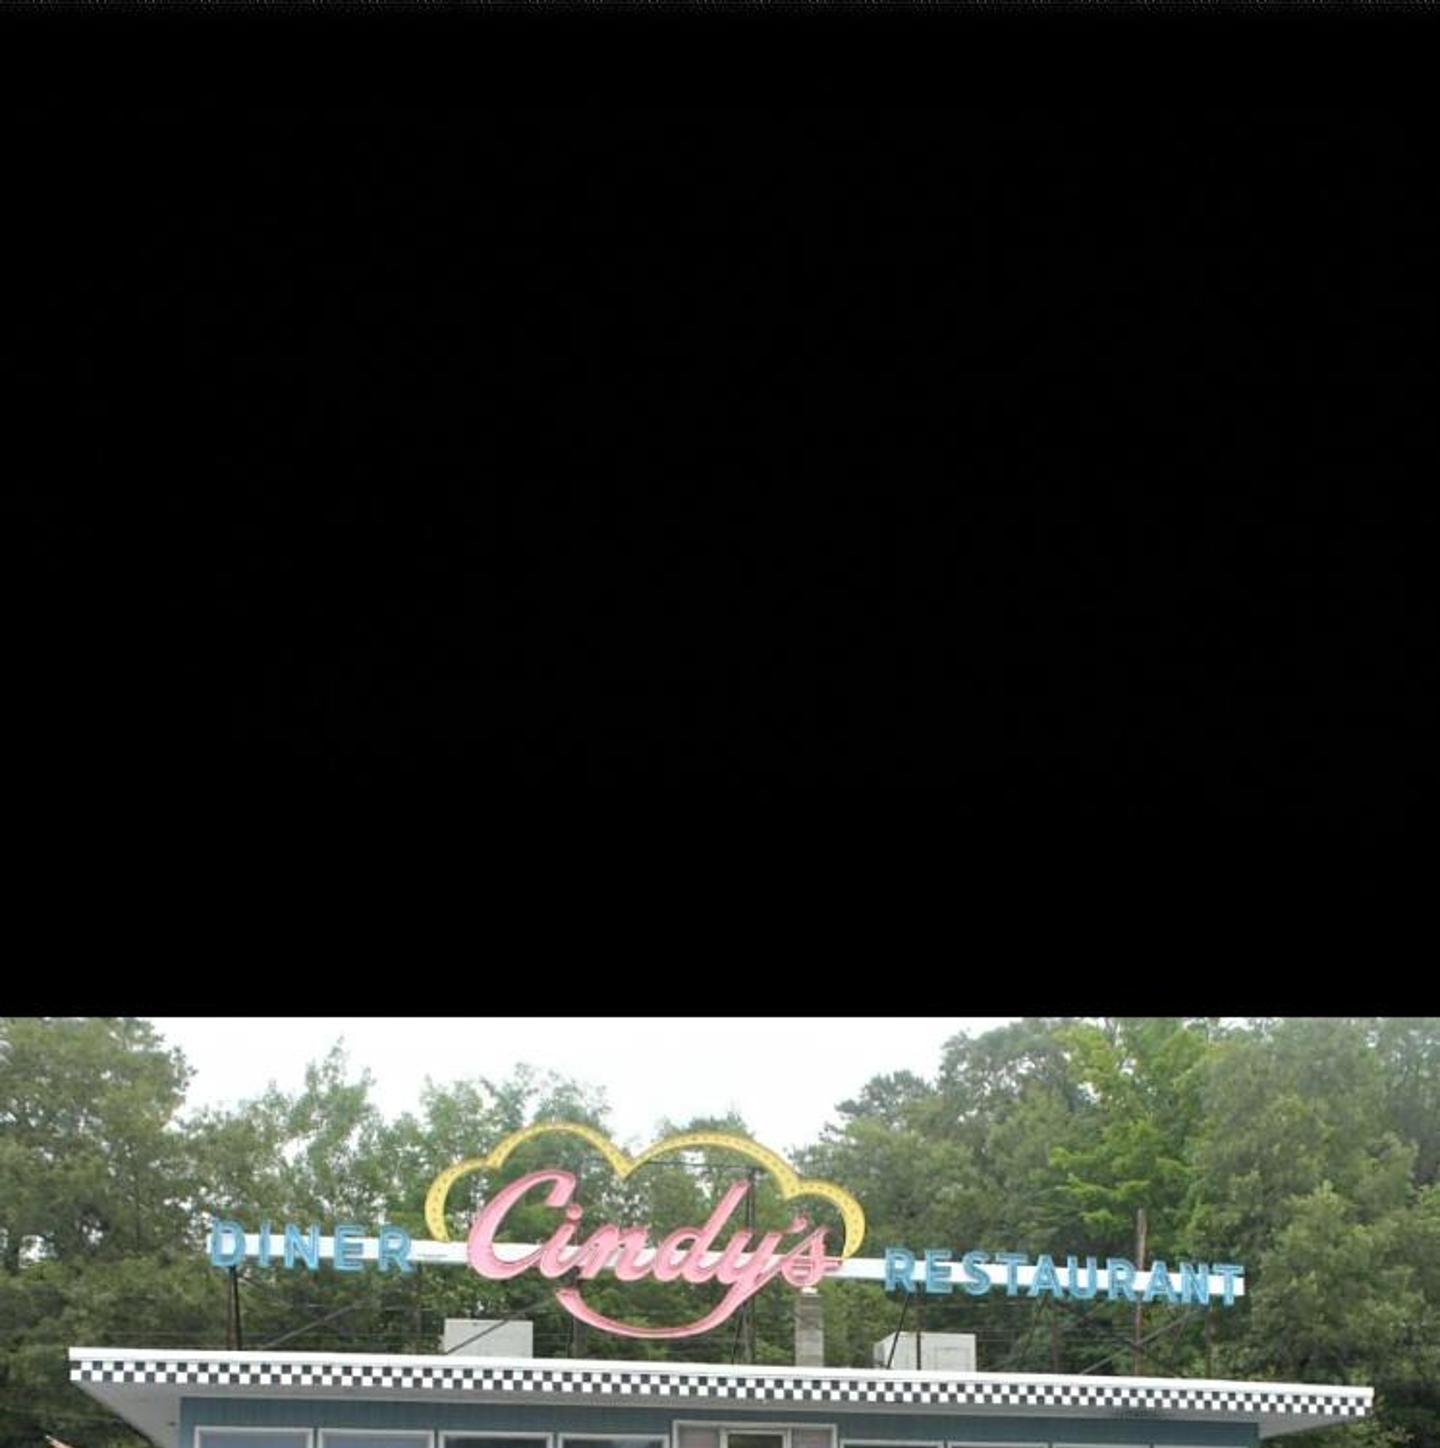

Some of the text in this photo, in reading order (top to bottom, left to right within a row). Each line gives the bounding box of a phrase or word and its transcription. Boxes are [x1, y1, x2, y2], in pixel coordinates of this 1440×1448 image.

[210, 1217, 414, 1272] DINER
[467, 1168, 843, 1338] Cindy's
[884, 1247, 1245, 1306] RESTAURANT
